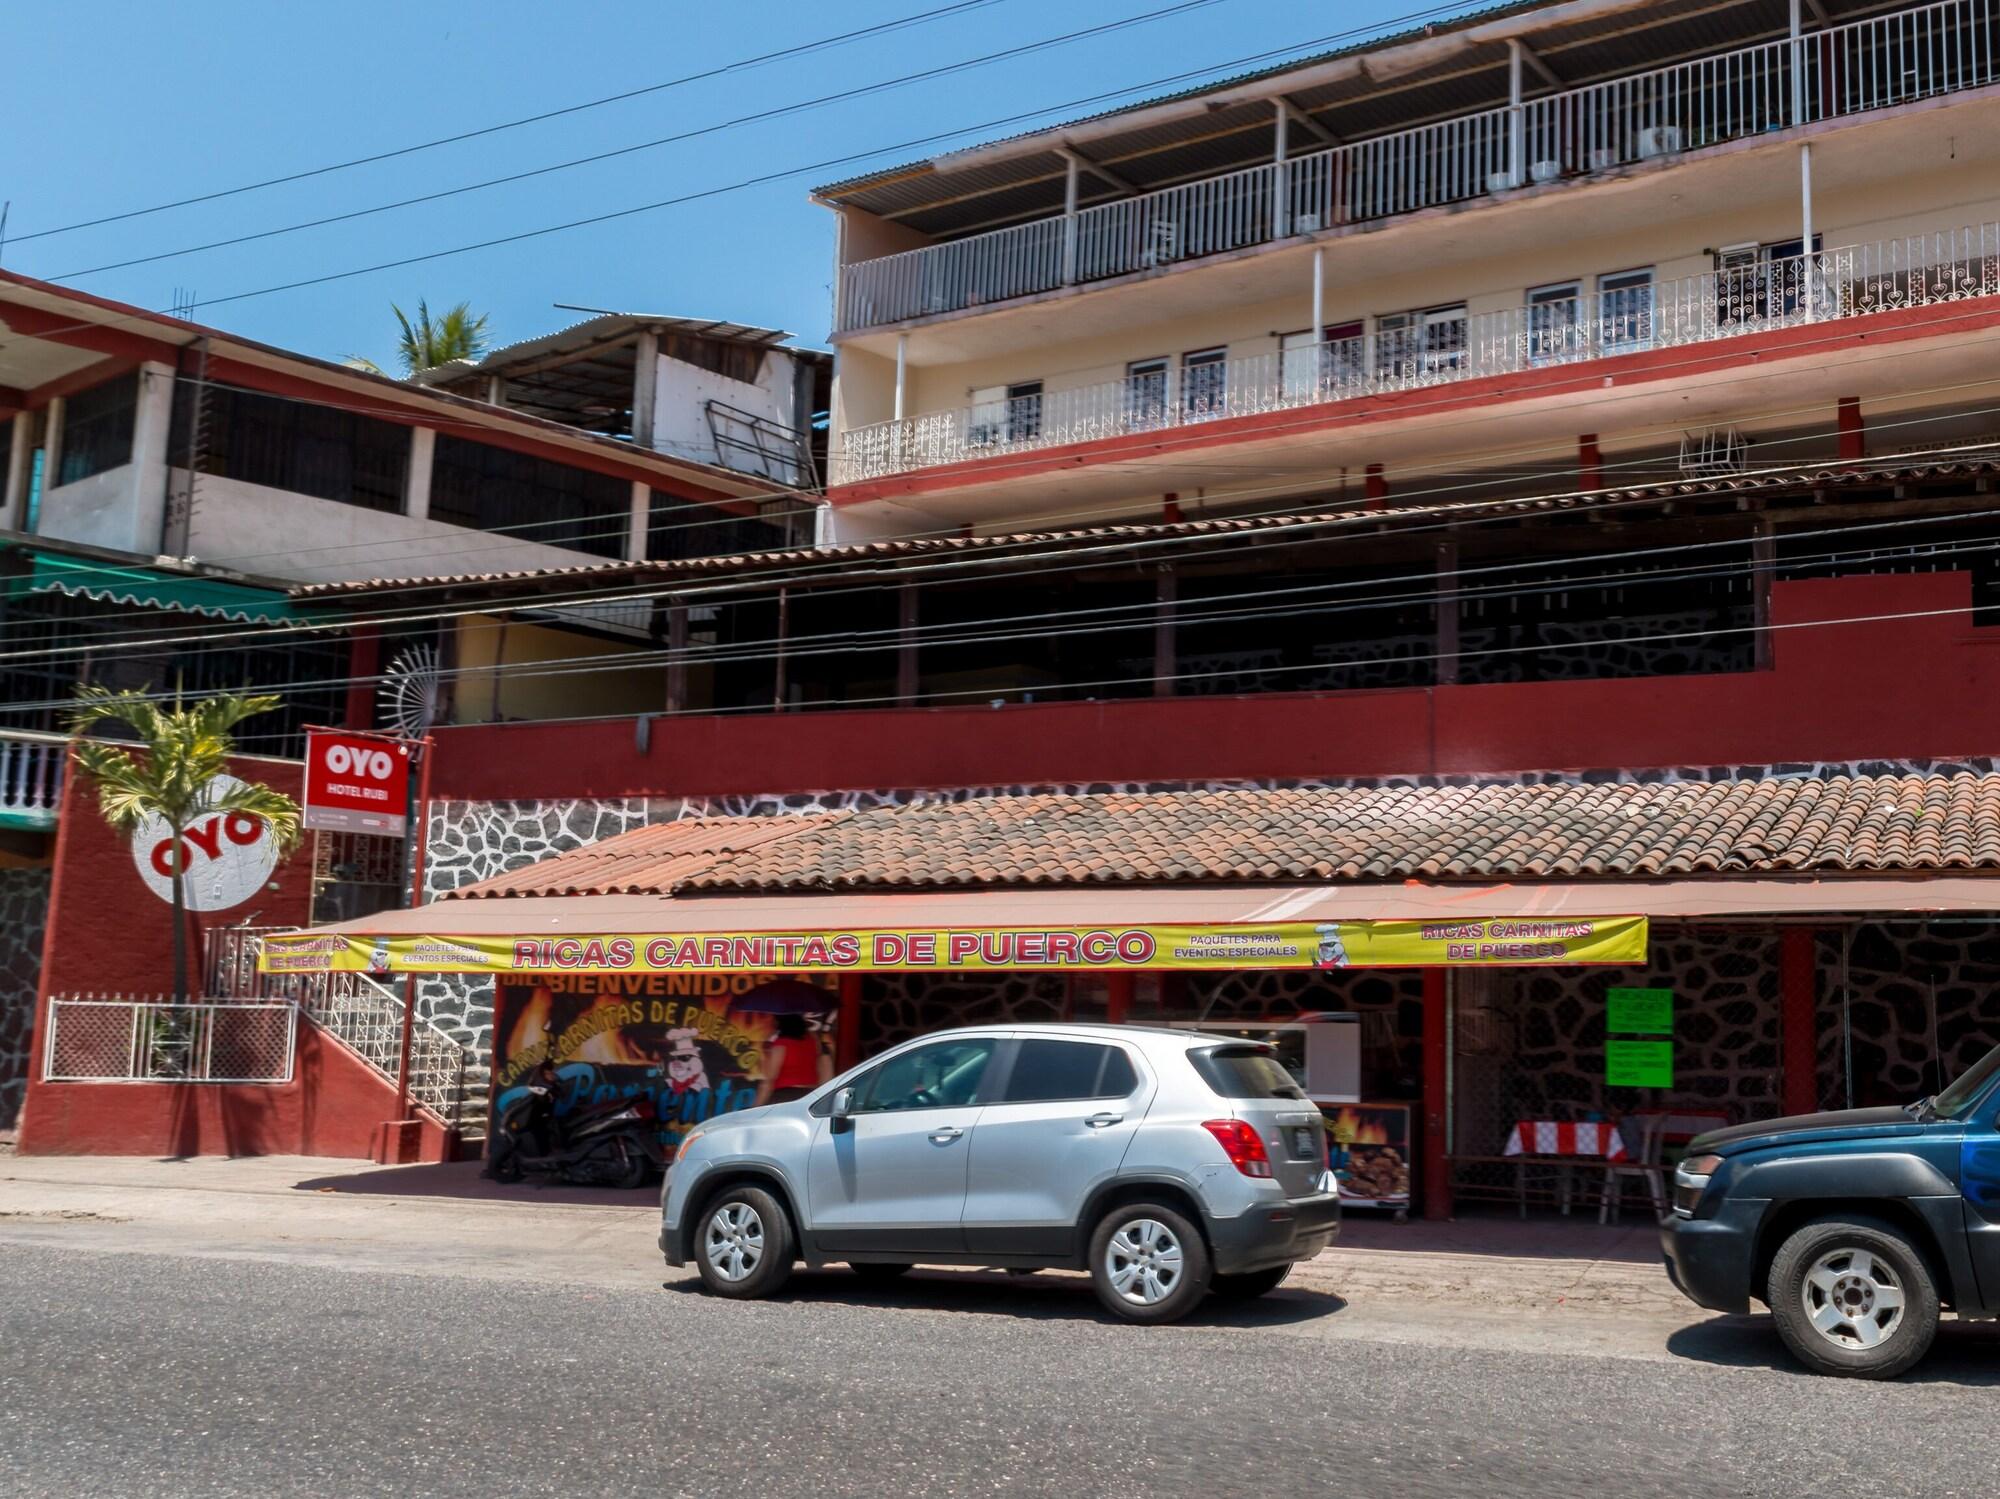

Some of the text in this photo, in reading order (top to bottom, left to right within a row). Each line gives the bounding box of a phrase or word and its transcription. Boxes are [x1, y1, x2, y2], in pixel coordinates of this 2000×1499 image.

[326, 745, 393, 779] OYO
[326, 783, 389, 801] HOTEL RUBI
[151, 810, 264, 878] OYO
[1190, 934, 1280, 945] PAQUETES PARA
[1422, 921, 1593, 940] RICAS CARNITAS
[415, 944, 456, 952] PAQUETES
[512, 930, 1156, 968] RICAS CARNITAS DE PUERCO
[1174, 947, 1297, 958] EVENTOS ESPECIALES
[1447, 942, 1568, 960] DE PUERCO
[403, 954, 488, 963] EVENTOS ESPECIALES
[650, 1000, 678, 1025] DE
